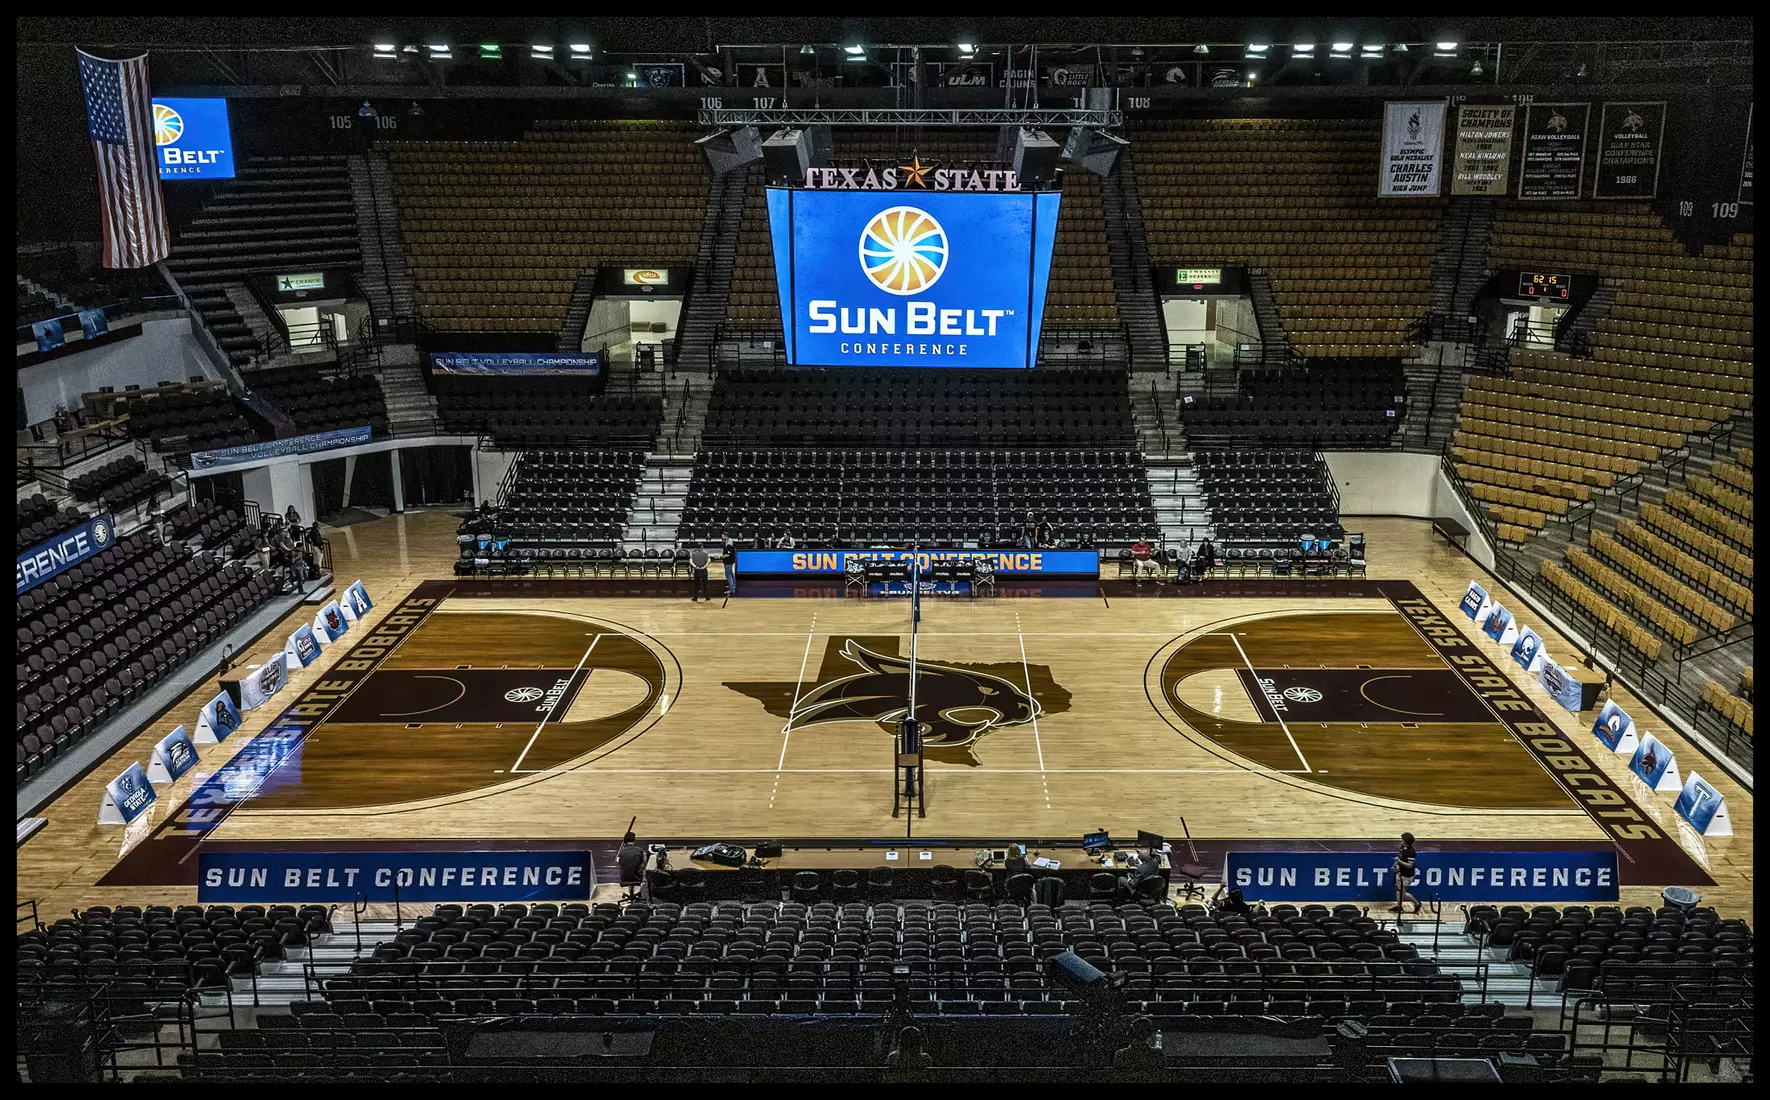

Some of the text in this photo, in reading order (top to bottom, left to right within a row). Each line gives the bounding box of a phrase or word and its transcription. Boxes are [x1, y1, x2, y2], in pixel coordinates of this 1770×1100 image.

[700, 96, 723, 110] 106
[752, 96, 775, 110] 107
[1462, 110, 1513, 118] SOCIETY OF
[329, 115, 352, 130] 105
[374, 115, 397, 130] 106
[1461, 119, 1512, 128] CHAMPIONS
[1390, 164, 1433, 173] CHARLES
[804, 166, 898, 190] TEXAS
[934, 168, 1022, 192] STATE
[1393, 174, 1429, 182] AUSTIN
[1616, 176, 1637, 184] 1986
[1392, 184, 1428, 192] HIGH JUMP
[1679, 200, 1694, 217] 109
[1712, 202, 1739, 218] 109
[809, 300, 896, 334] SUN
[840, 342, 967, 356] CONFERENCE
[436, 358, 454, 367] SUN
[536, 359, 598, 367] CHAMPIONSHIP
[220, 434, 322, 457] SUN BELT CONFERENCE
[310, 434, 369, 450] CHAMPIONSHIP
[250, 444, 308, 460] VOLLEYBALL
[792, 554, 838, 570] SUN
[335, 596, 436, 672] BOBCATS
[535, 678, 570, 712] SUN BELT
[1258, 678, 1289, 712] SUN BELT
[1396, 599, 1662, 840] TEXAS STATE BOBCATS
[124, 787, 146, 808] GEORGIA
[130, 796, 146, 811] STATE
[1694, 782, 1712, 818] T
[205, 866, 583, 888] SUN BELT CONFERENCE
[1236, 867, 1297, 887] SUN
[1314, 867, 1388, 887] BELT
